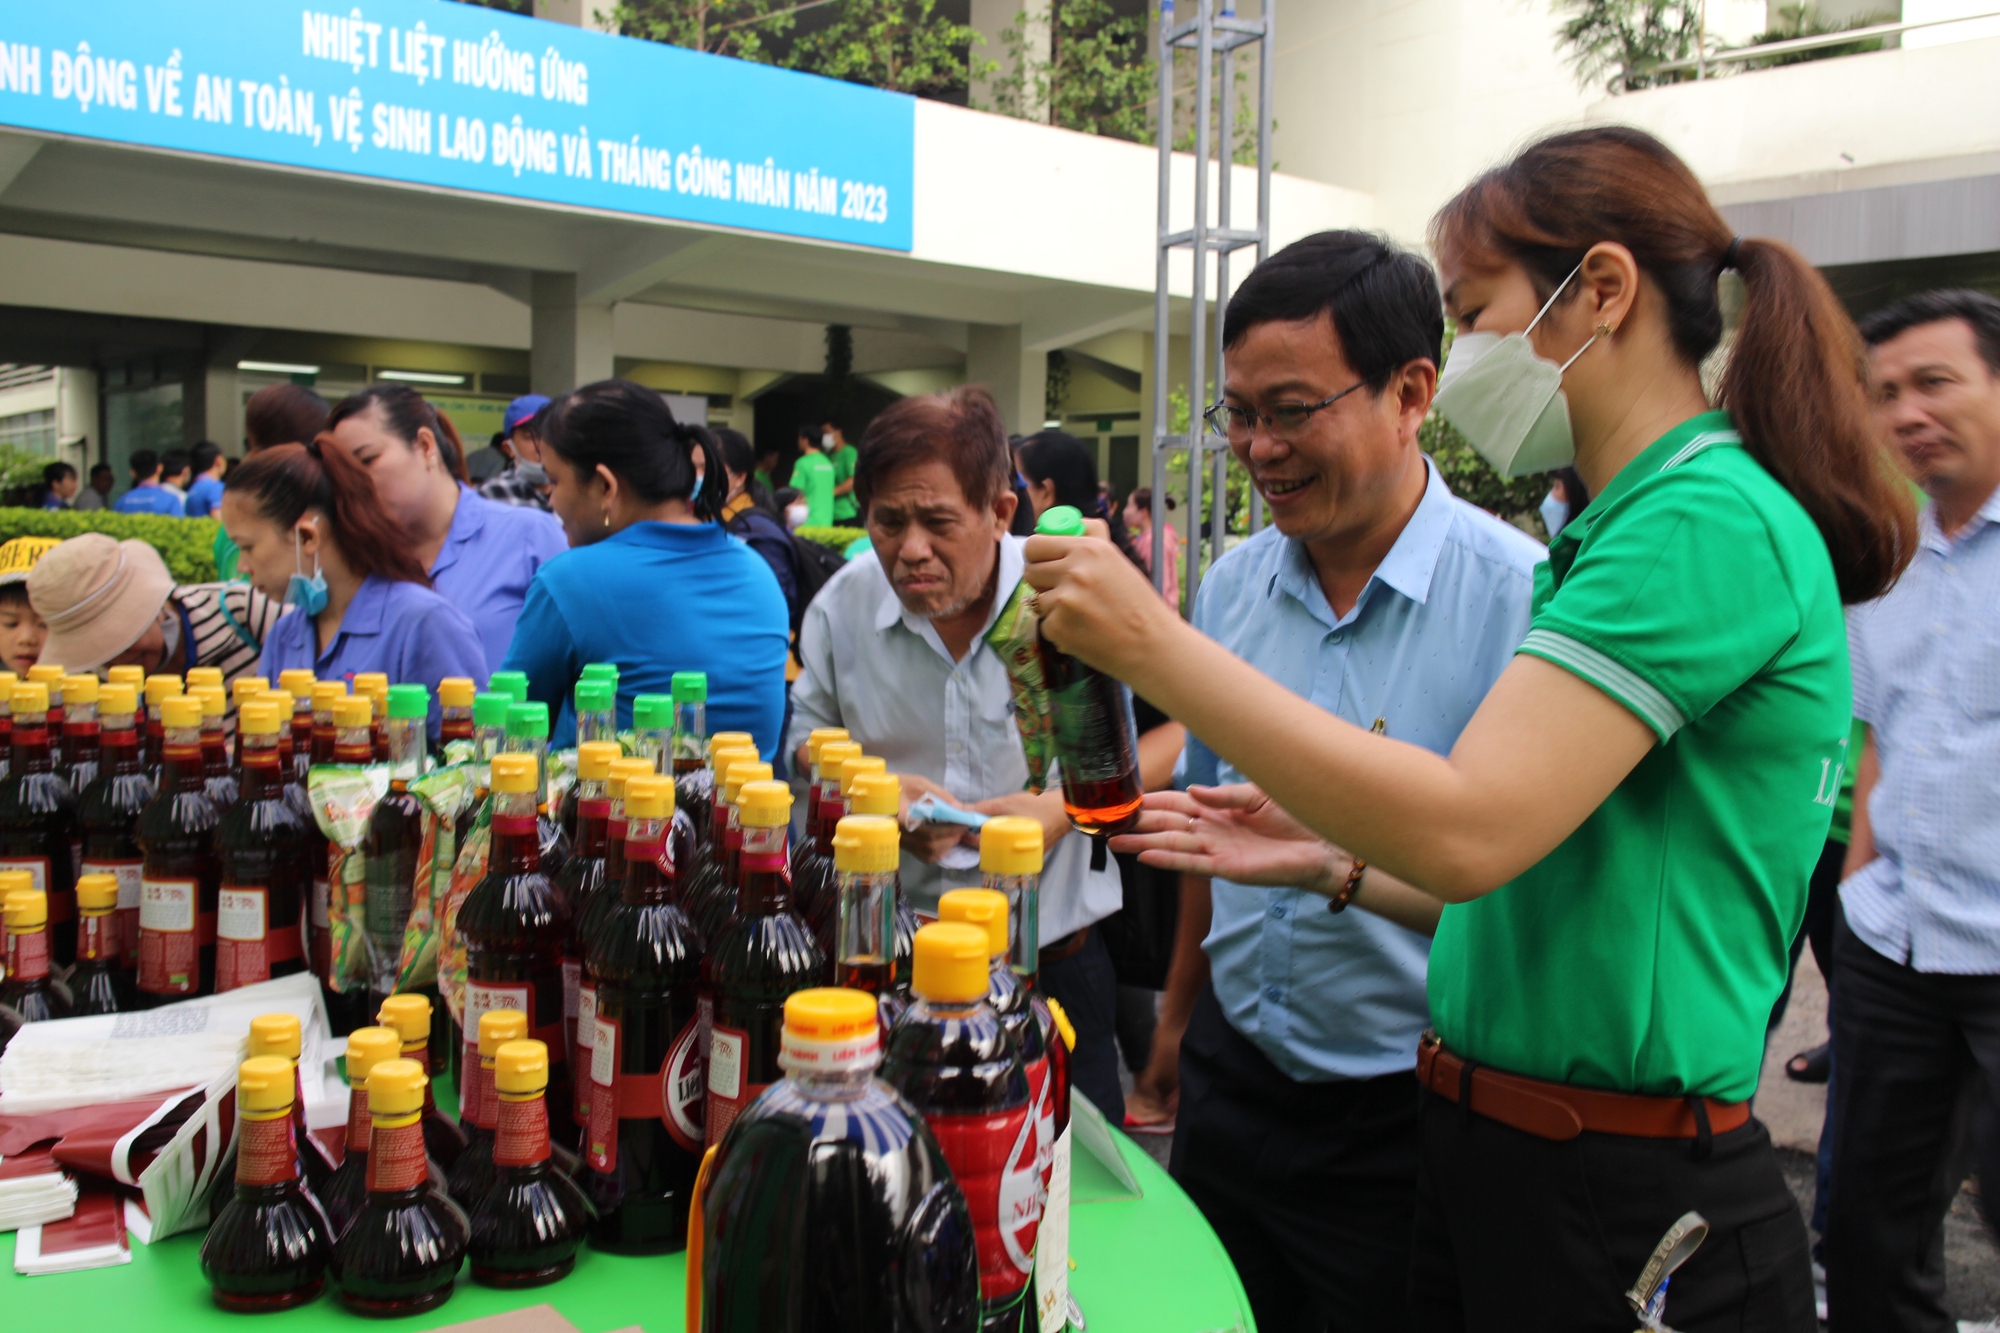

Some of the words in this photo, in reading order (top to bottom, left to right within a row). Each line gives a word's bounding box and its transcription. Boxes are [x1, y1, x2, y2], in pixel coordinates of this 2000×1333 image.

[302, 7, 382, 74] NHIỆT
[389, 20, 446, 85] LIỆT
[453, 29, 535, 96] HƯỞNG
[540, 46, 588, 106] ỨNG
[51, 41, 137, 113] ĐỘNG
[144, 48, 183, 117] VỀ
[193, 73, 232, 125] AN
[239, 74, 322, 147] TOÀN,
[328, 87, 364, 152] VỆ
[371, 102, 431, 155] SINH
[438, 113, 487, 164] LAO
[491, 115, 557, 177] ĐỘNG
[561, 126, 592, 180] VÀ
[597, 135, 671, 191] THÁNG
[675, 145, 732, 200] CÔNG
[736, 157, 790, 208] NHÂN
[795, 168, 837, 216] NĂM
[841, 180, 888, 224] 2023
[0, 543, 53, 569] BER
